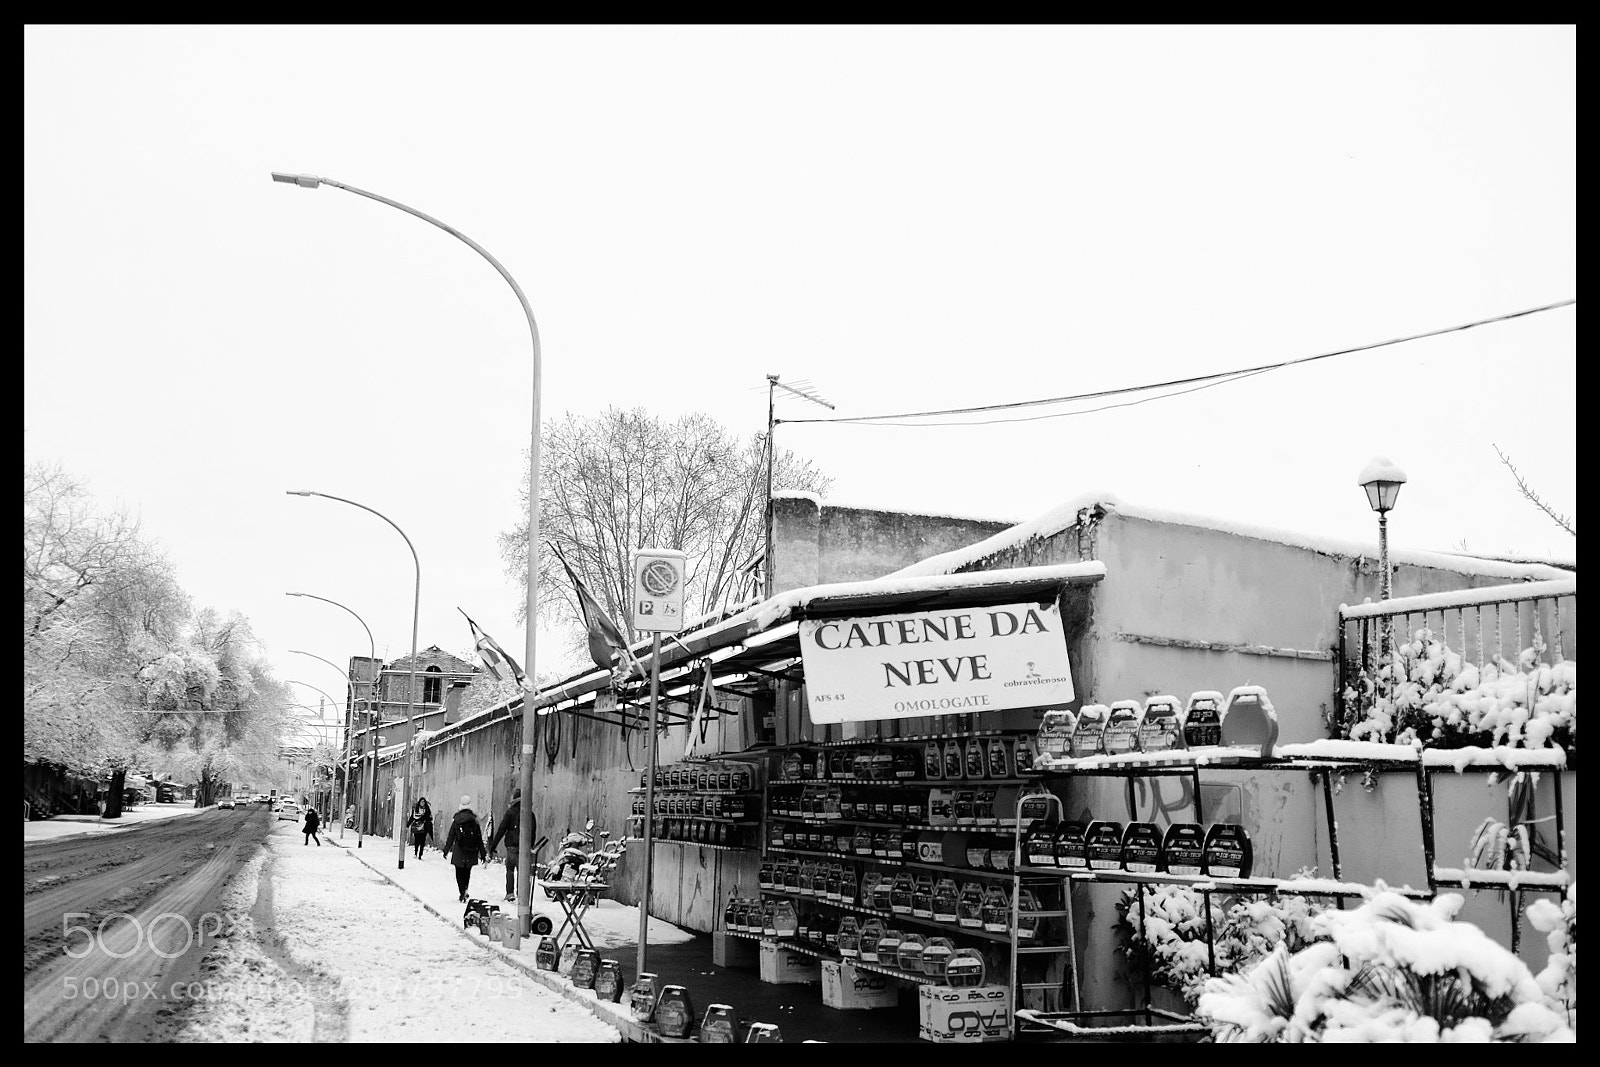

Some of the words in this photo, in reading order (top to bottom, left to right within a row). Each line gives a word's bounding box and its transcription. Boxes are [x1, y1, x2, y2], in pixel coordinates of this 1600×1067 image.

[814, 614, 976, 650] CATENE
[987, 608, 1050, 638] DA
[881, 654, 992, 689] NEVE
[1003, 677, 1067, 688] cobravelenoso
[814, 695, 832, 703] AFS
[834, 693, 846, 701] 43
[894, 694, 990, 713] OMOLOGATE
